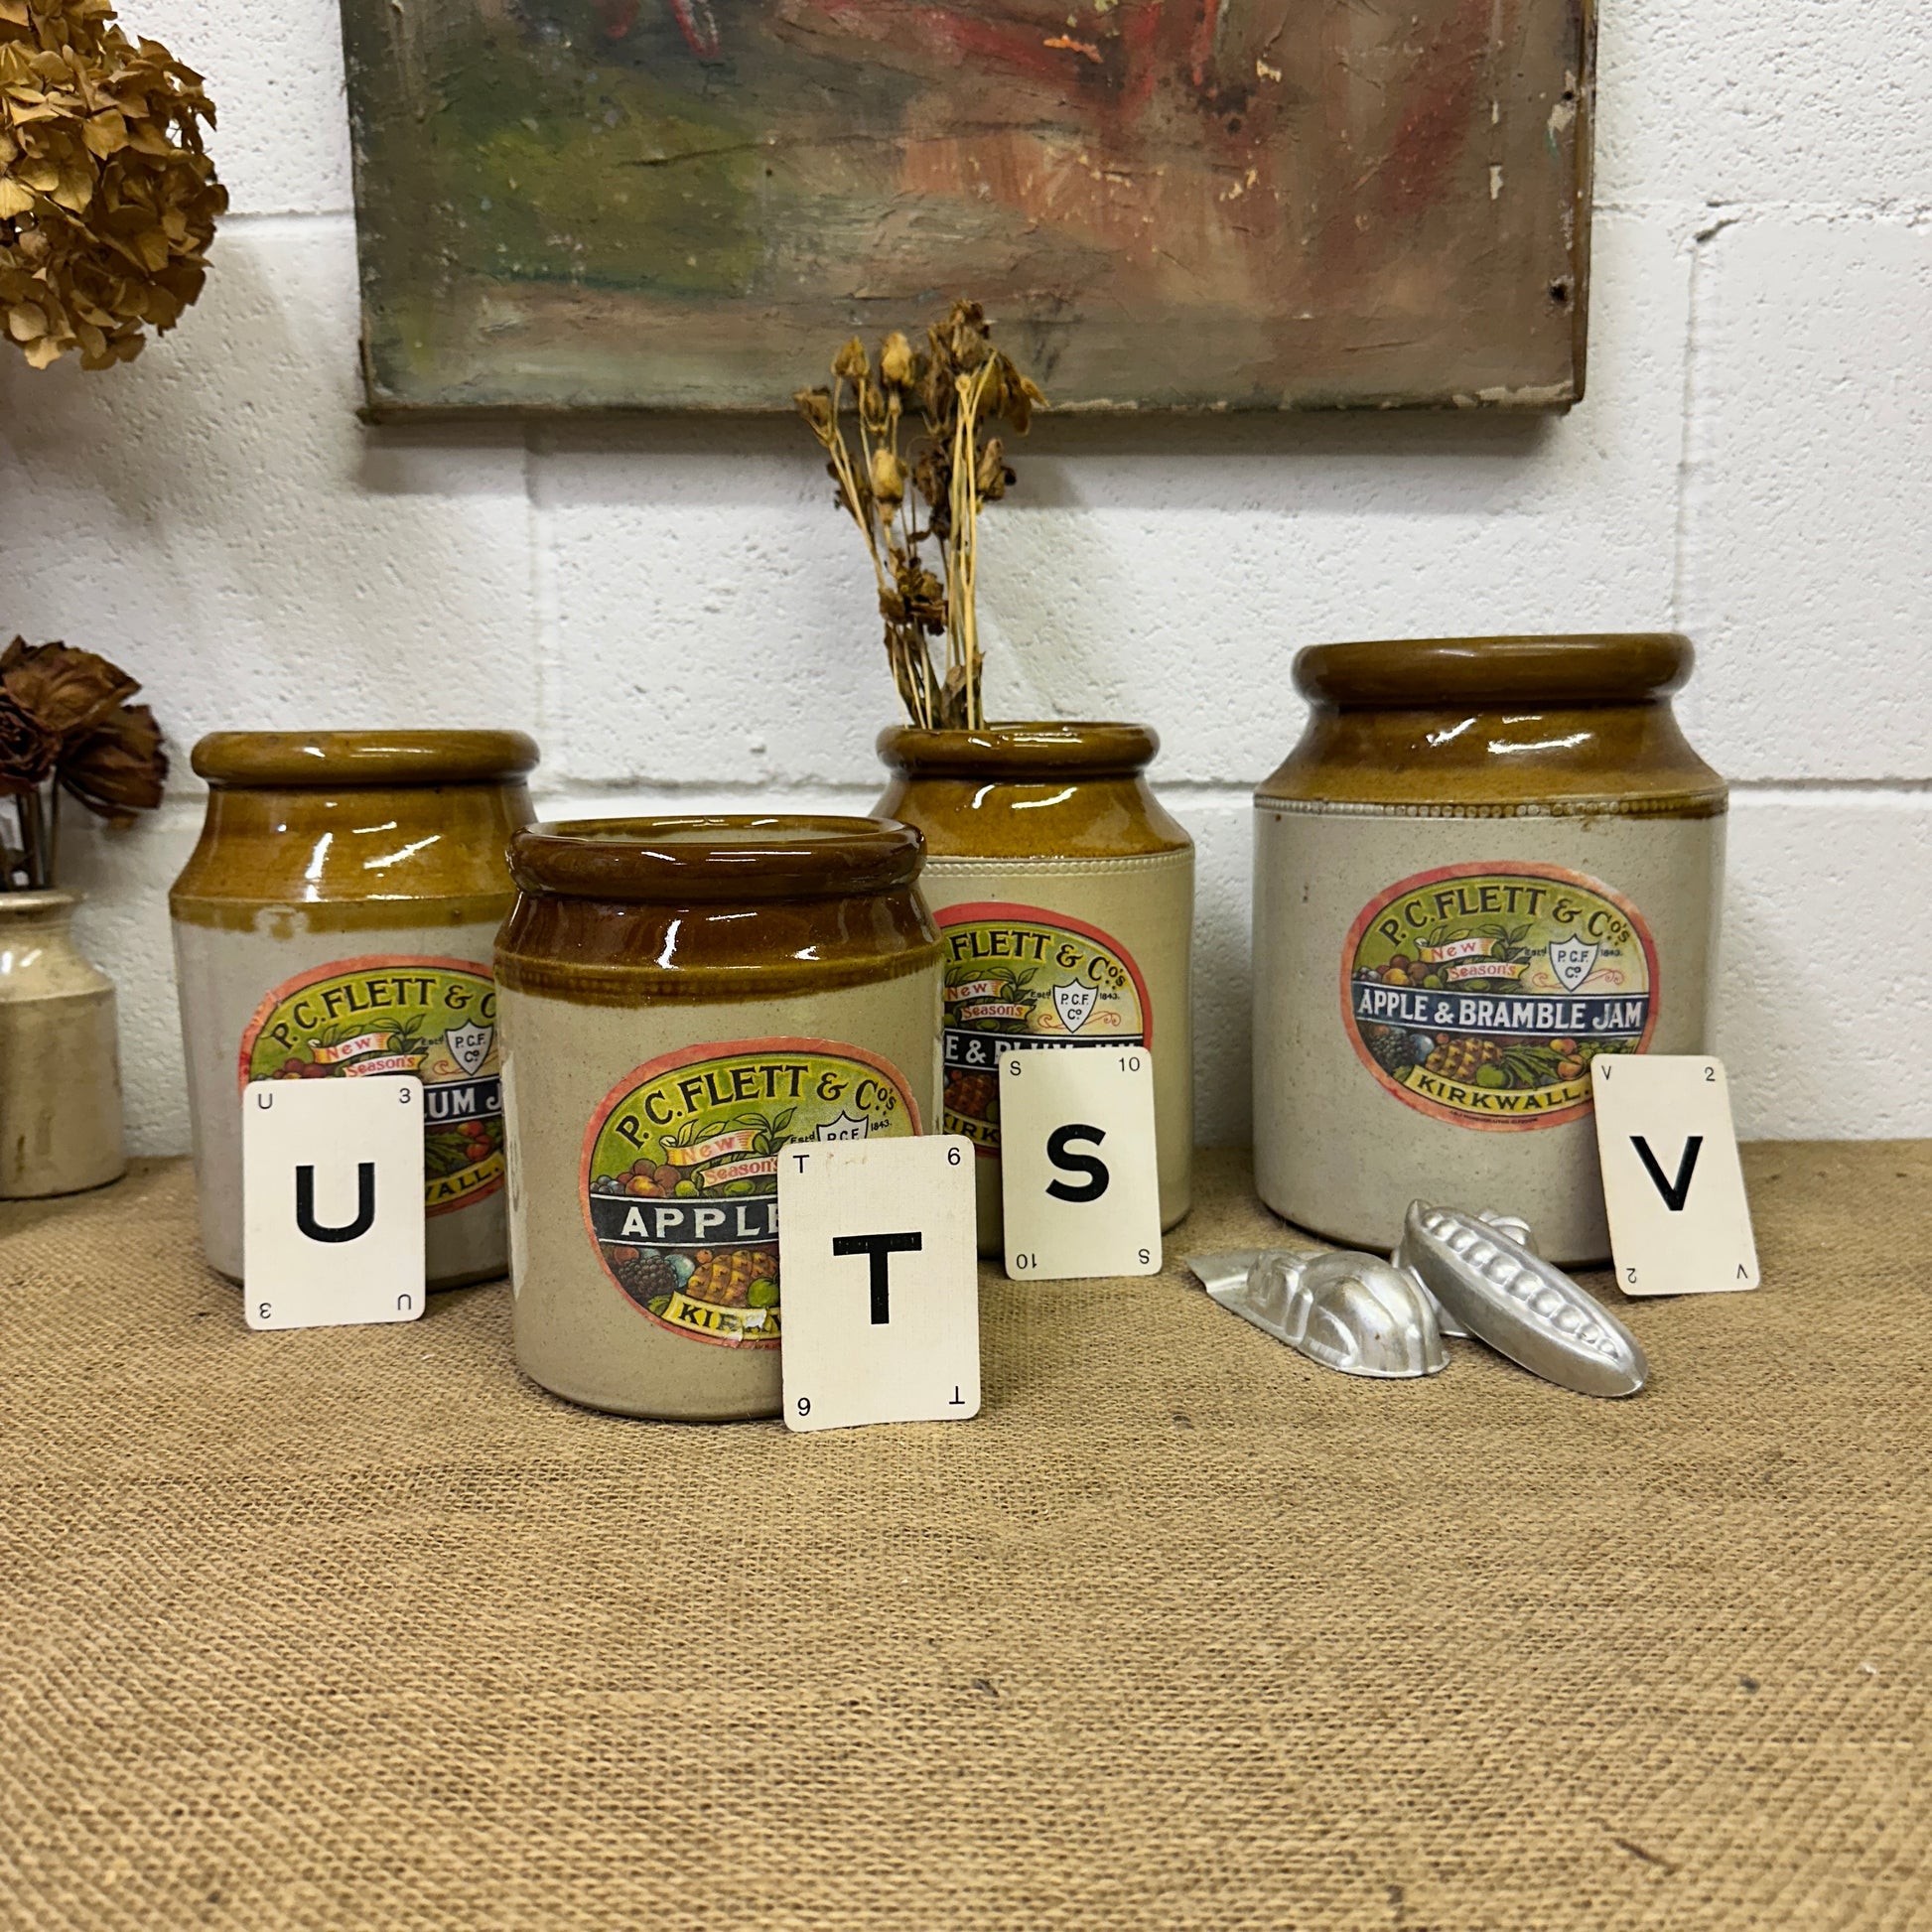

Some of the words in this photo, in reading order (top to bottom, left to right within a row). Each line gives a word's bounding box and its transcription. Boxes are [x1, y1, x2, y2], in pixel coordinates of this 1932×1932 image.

[1552, 898, 1582, 923] &
[1056, 944, 1082, 968] &
[445, 985, 473, 1010] &
[1357, 989, 1428, 1023] APPLE
[1434, 1002, 1455, 1025] &
[1458, 1000, 1586, 1030] BRAMBLE
[1592, 1003, 1641, 1030] JAM
[963, 1005, 1024, 1019] Season's
[965, 1039, 986, 1064] &
[1010, 1060, 1022, 1076] S
[1118, 1056, 1140, 1072] 10
[1600, 1065, 1612, 1080] V
[1704, 1067, 1716, 1081] 2
[399, 1088, 411, 1104] 3
[817, 1072, 849, 1101] &
[258, 1093, 273, 1110] U
[425, 1087, 476, 1119] UM
[681, 1137, 736, 1165] New
[947, 1147, 961, 1166] 6
[1045, 1124, 1110, 1202] S
[793, 1155, 810, 1173] T
[1629, 1136, 1704, 1211] V
[296, 1162, 375, 1243] U
[1138, 1249, 1150, 1264] S
[832, 1231, 922, 1324] T
